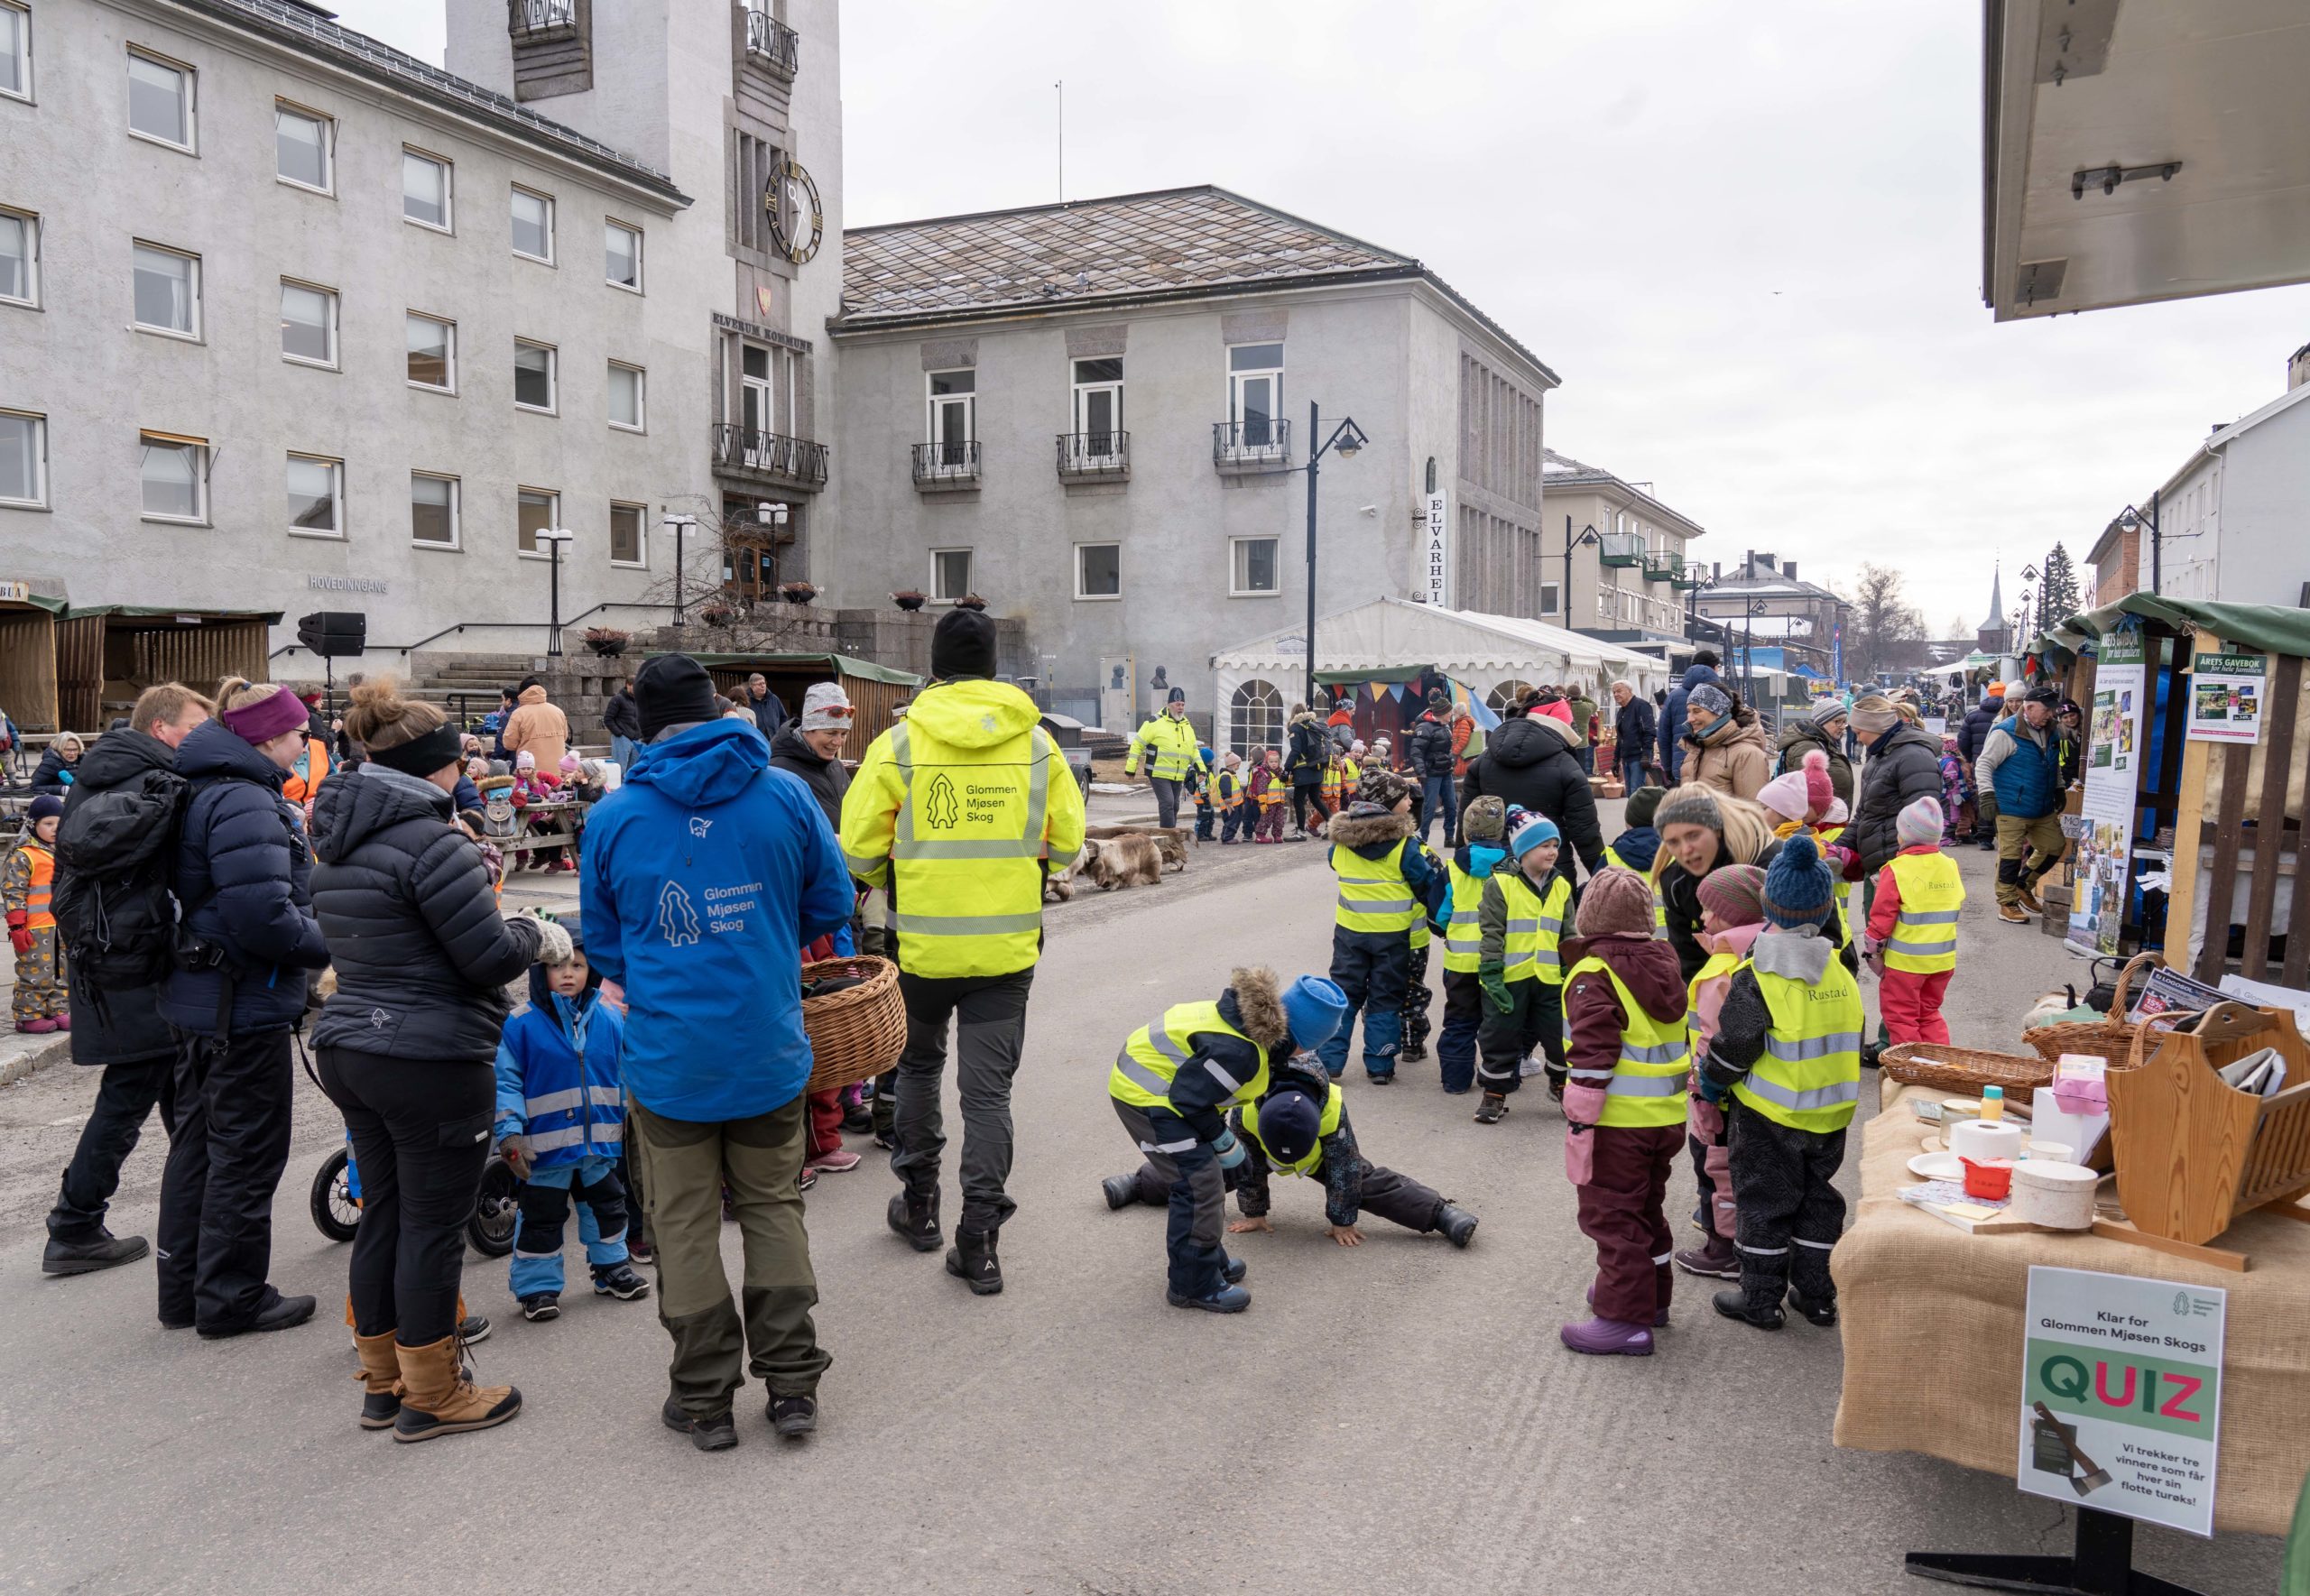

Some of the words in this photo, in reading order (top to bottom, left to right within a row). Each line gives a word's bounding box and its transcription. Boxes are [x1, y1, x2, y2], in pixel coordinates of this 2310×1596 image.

[713, 311, 761, 337] ELVERUM
[764, 328, 813, 353] KOMMUNE
[1429, 499, 1444, 607] ELVARHEI
[310, 576, 389, 594] HOVEDINNGANG
[2200, 655, 2222, 666] ÅRETS
[2224, 659, 2259, 669] GAVEBOK
[2209, 665, 2220, 673] for
[2221, 663, 2233, 672] hele
[2233, 665, 2262, 675] familien
[966, 784, 1018, 795] Glommen
[966, 798, 1005, 810] Mjøsen
[966, 812, 993, 824] Skog
[1928, 881, 1955, 890] Rustad
[707, 900, 755, 918] Mjøsen
[709, 919, 744, 934] Skog
[1807, 984, 1849, 1001] Rustad
[2162, 976, 2194, 993] LOGOSOL
[2146, 997, 2164, 1010] 15%
[2096, 1310, 2125, 1324] Klar
[2129, 1315, 2149, 1328] for
[2040, 1317, 2107, 1337] Glommen
[2111, 1326, 2160, 1345] Mjøsen
[2164, 1335, 2207, 1353] Skogs
[2039, 1354, 2203, 1423] QUIZ
[2122, 1443, 2135, 1453] Vi
[2137, 1445, 2180, 1463] trekker
[2183, 1454, 2200, 1468] tre
[2115, 1454, 2158, 1471] vinnere
[2161, 1465, 2186, 1478] som
[2188, 1469, 2206, 1482] får
[2137, 1471, 2163, 1485] hver
[2165, 1477, 2182, 1490] sin
[2121, 1481, 2153, 1497] flotte
[2155, 1489, 2197, 1507] turøks!
